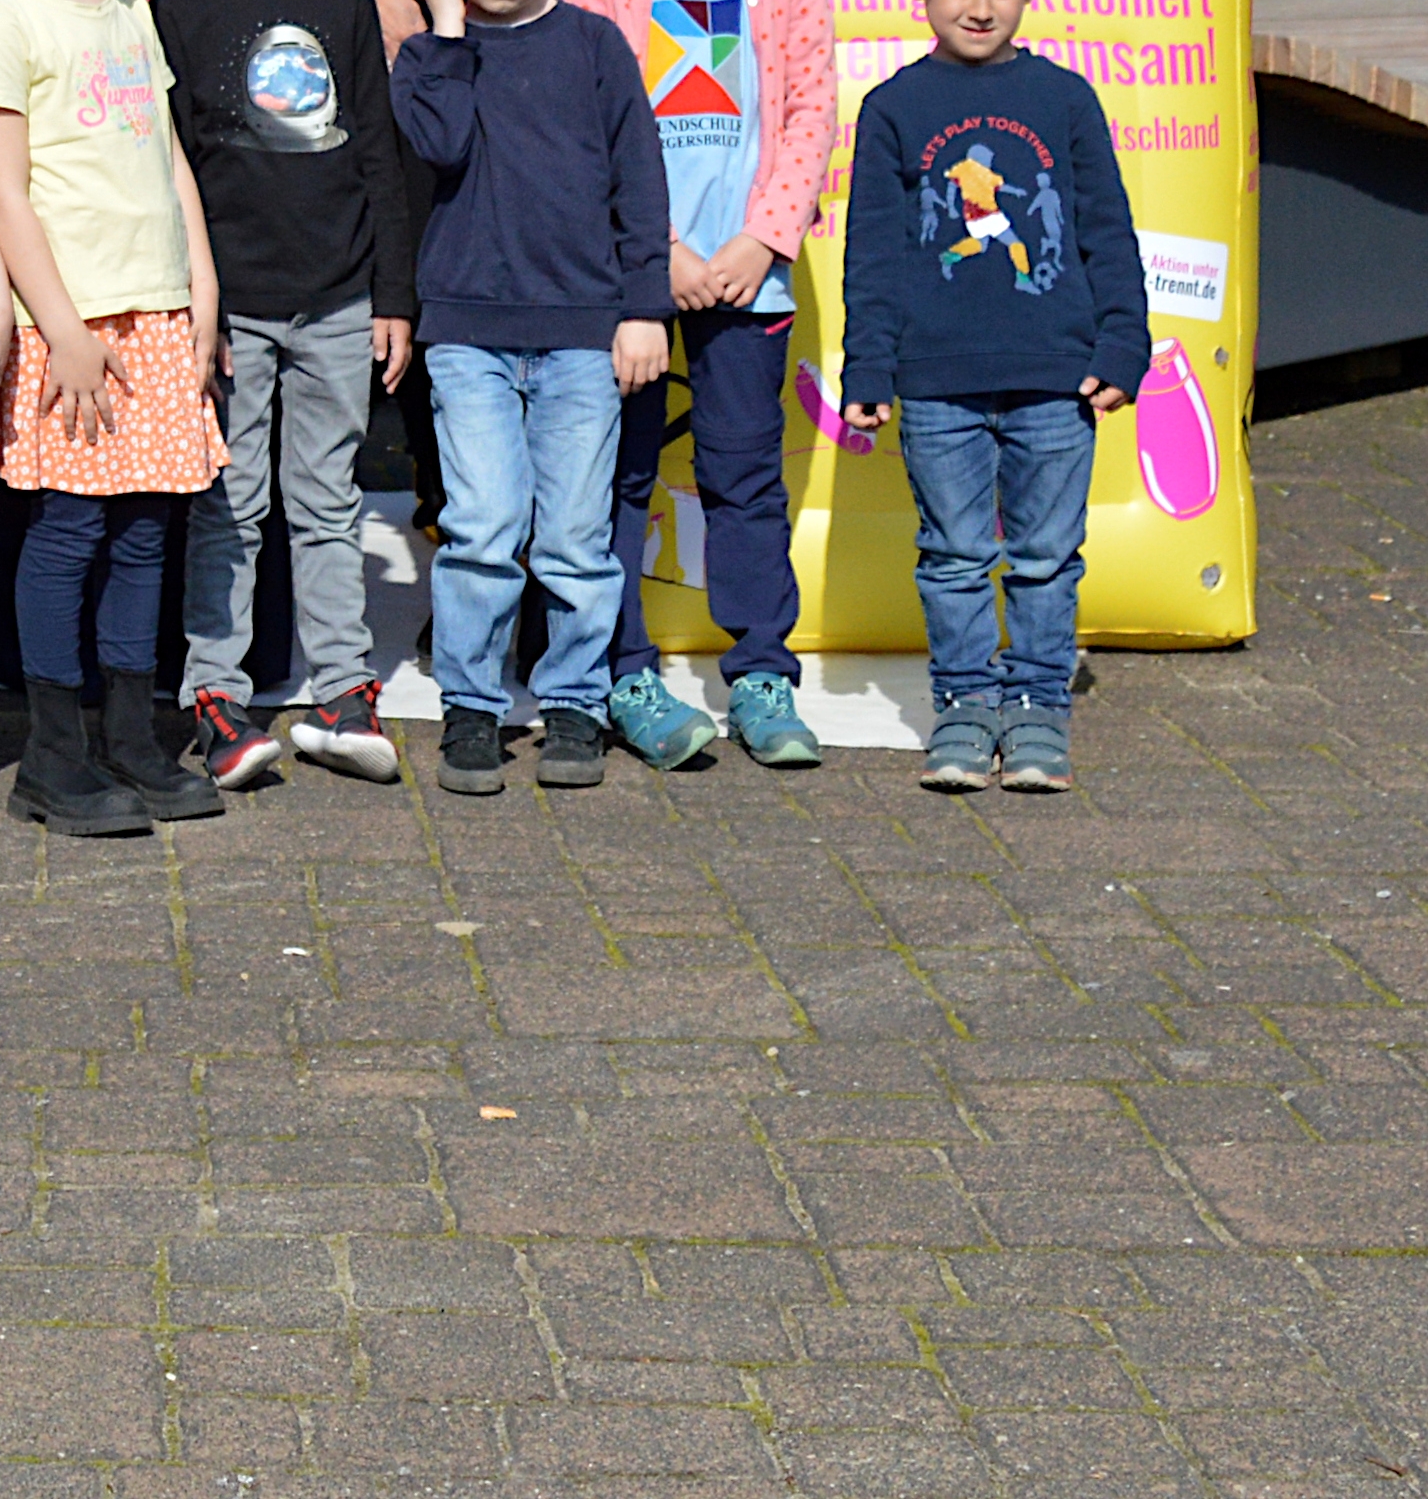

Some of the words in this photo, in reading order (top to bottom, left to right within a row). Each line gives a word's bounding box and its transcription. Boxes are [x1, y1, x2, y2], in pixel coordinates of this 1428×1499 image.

[77, 73, 155, 128] Summe
[944, 116, 982, 139] PLAY
[986, 116, 1054, 169] TOGETHER
[1111, 114, 1220, 151] tschland
[1150, 253, 1190, 274] Aktion
